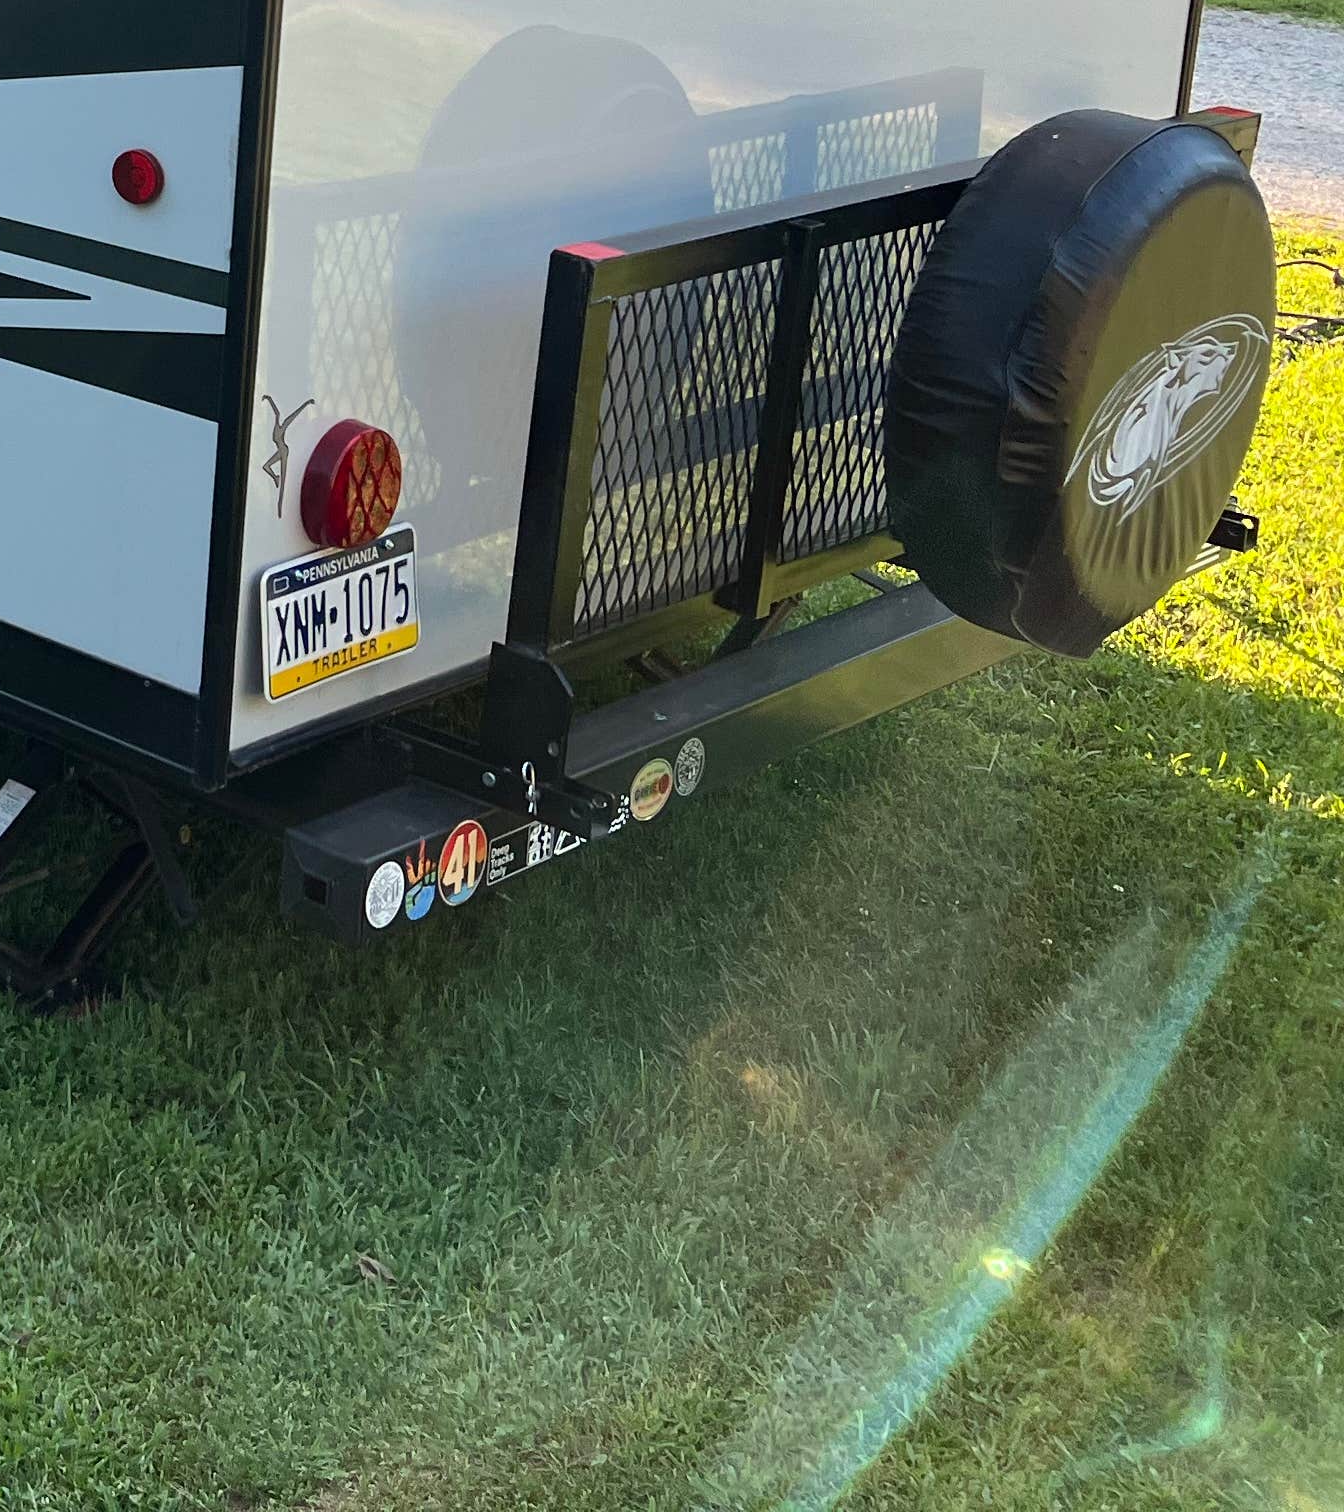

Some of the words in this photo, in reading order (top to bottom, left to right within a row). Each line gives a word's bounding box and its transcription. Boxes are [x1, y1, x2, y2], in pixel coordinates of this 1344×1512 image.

[303, 546, 380, 584] PENNSYLVANIA
[313, 638, 378, 675] TRAILER
[442, 828, 478, 895] 41
